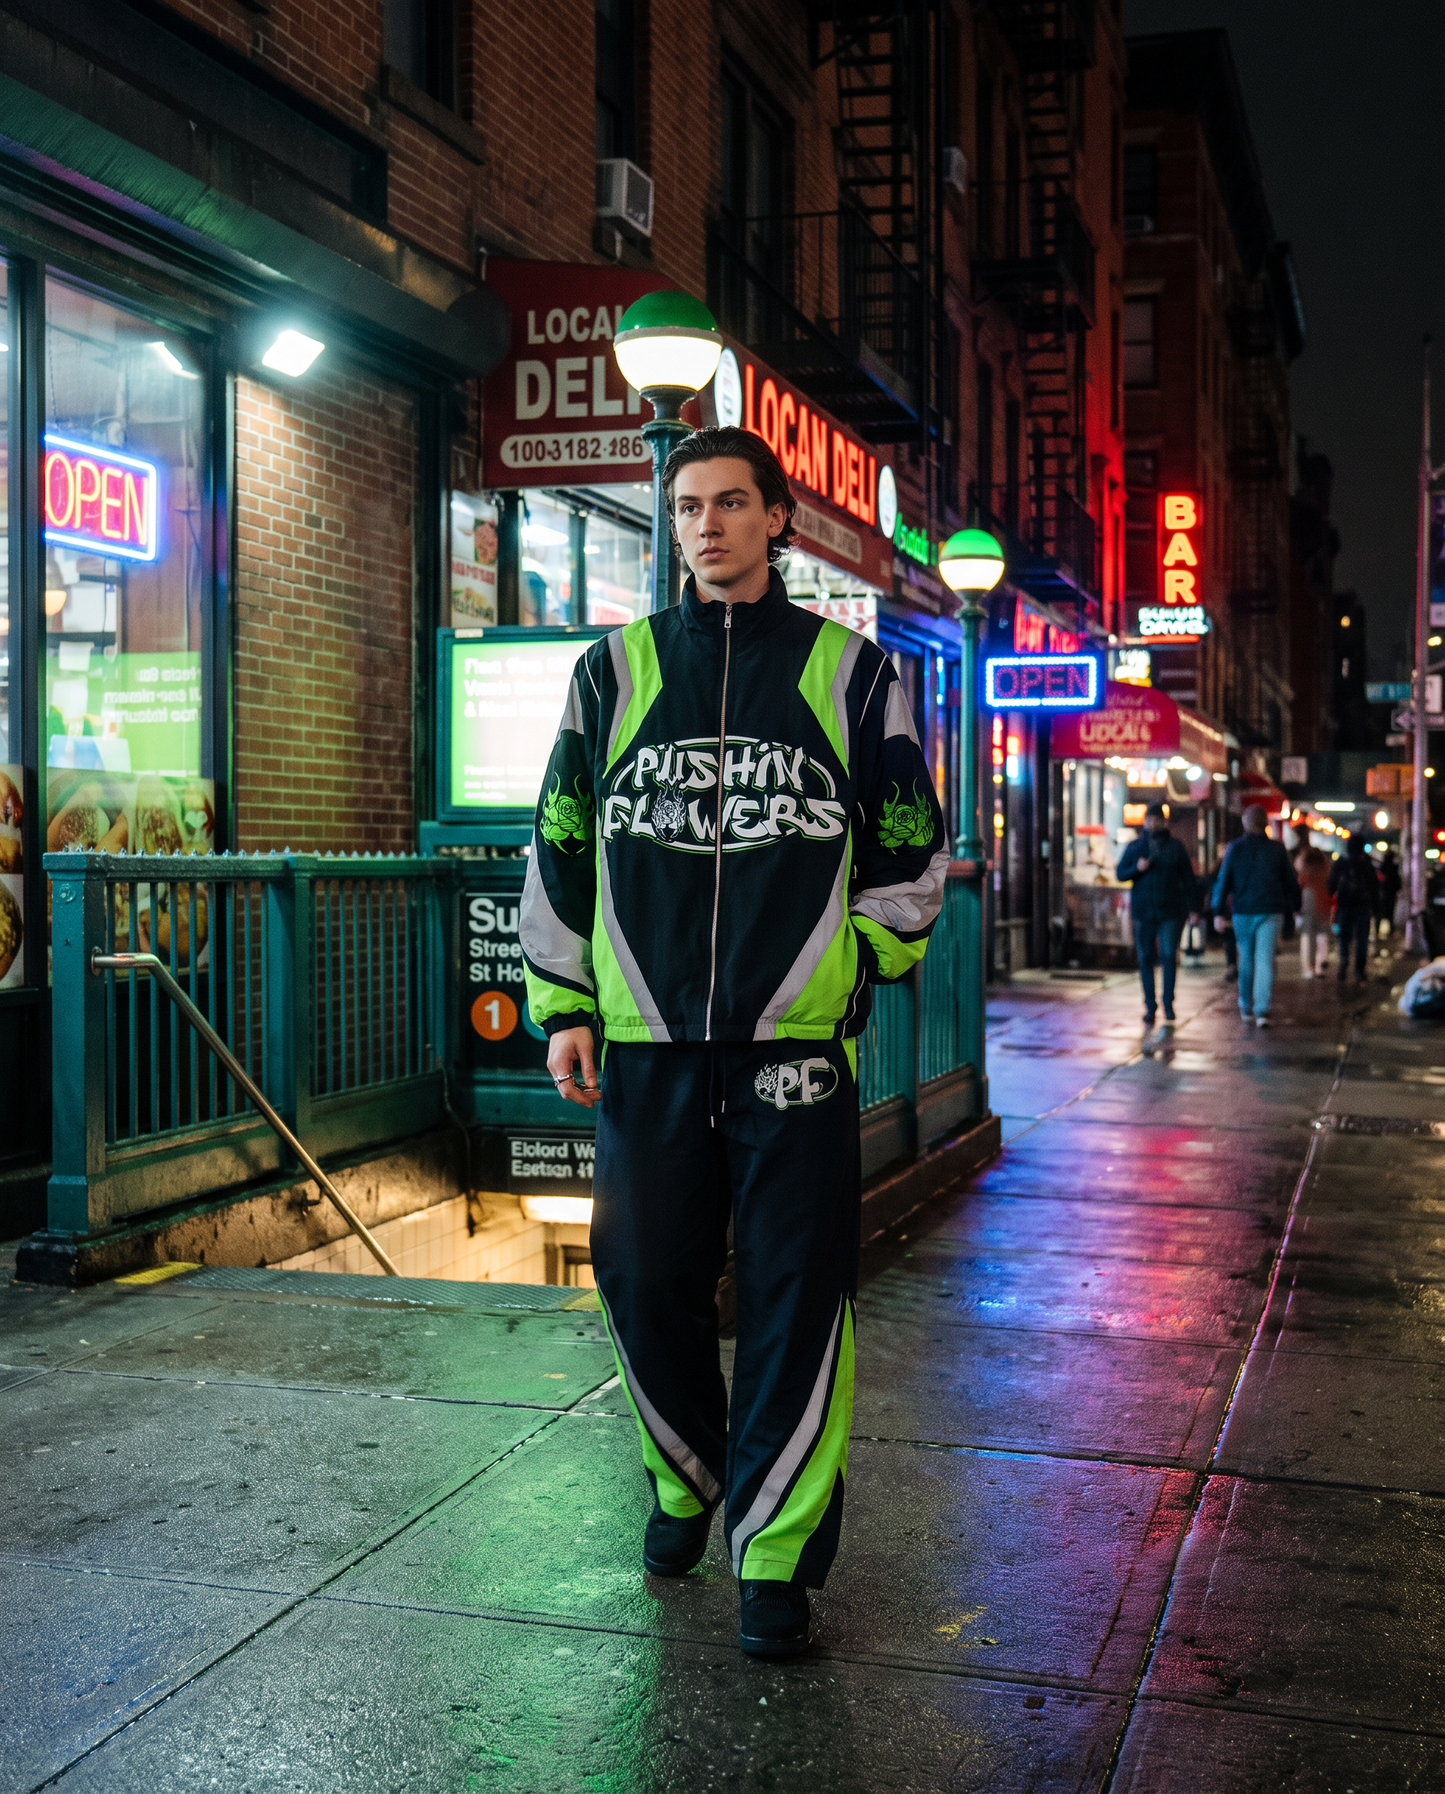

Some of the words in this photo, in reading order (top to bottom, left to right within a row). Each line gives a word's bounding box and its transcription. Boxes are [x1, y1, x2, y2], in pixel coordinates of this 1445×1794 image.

[527, 304, 624, 345] LOCA
[832, 428, 877, 527] DELI
[44, 451, 149, 546] OPEN
[1162, 494, 1198, 605] BAR
[994, 665, 1089, 698] OPEN
[468, 962, 492, 983] St
[484, 999, 500, 1031] 1
